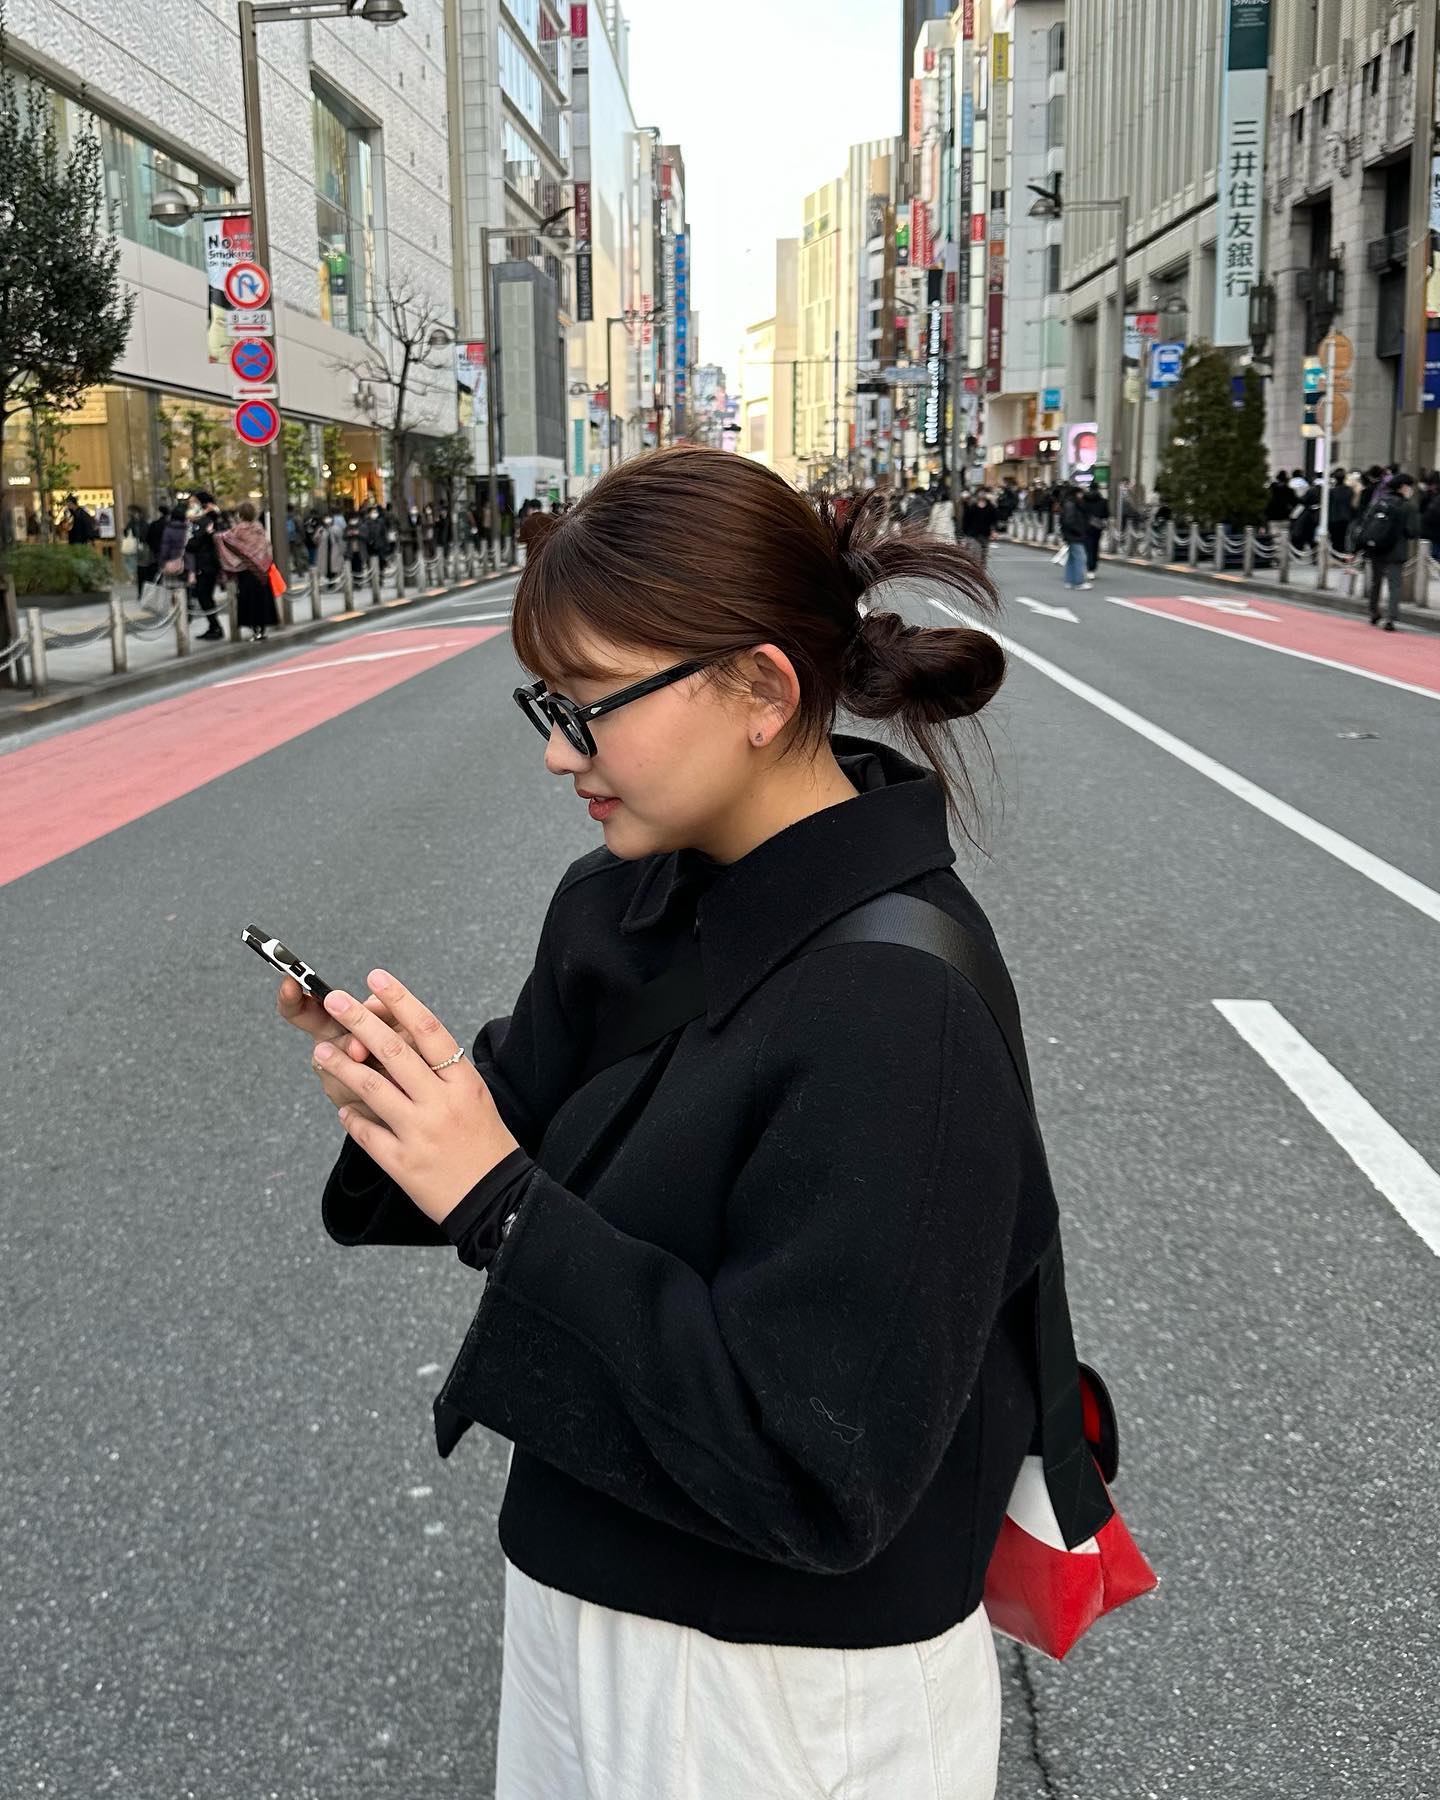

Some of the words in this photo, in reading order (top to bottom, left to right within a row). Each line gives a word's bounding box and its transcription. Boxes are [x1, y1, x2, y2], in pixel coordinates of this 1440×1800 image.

[1225, 120, 1258, 297] 三井住友銀行
[208, 234, 230, 249] No
[208, 250, 255, 260] Smoking
